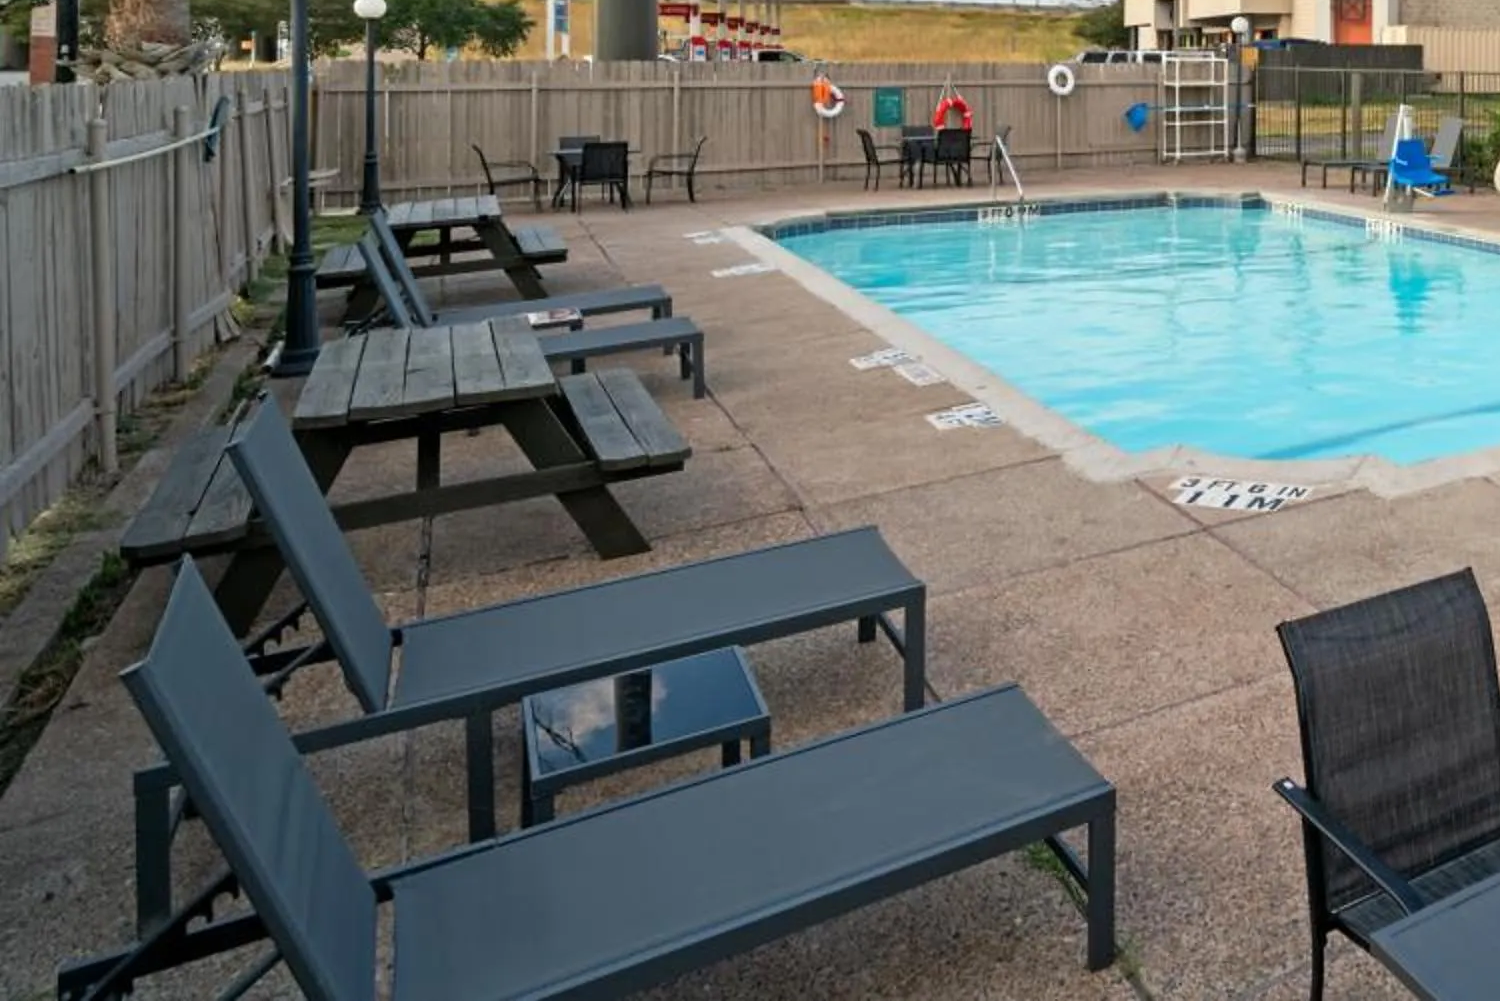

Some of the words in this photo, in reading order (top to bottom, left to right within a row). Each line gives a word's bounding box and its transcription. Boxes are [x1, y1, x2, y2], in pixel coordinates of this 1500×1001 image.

[1180, 478, 1201, 489] 3
[1207, 480, 1238, 492] FT
[1278, 486, 1308, 498] IN
[1247, 496, 1286, 511] M
